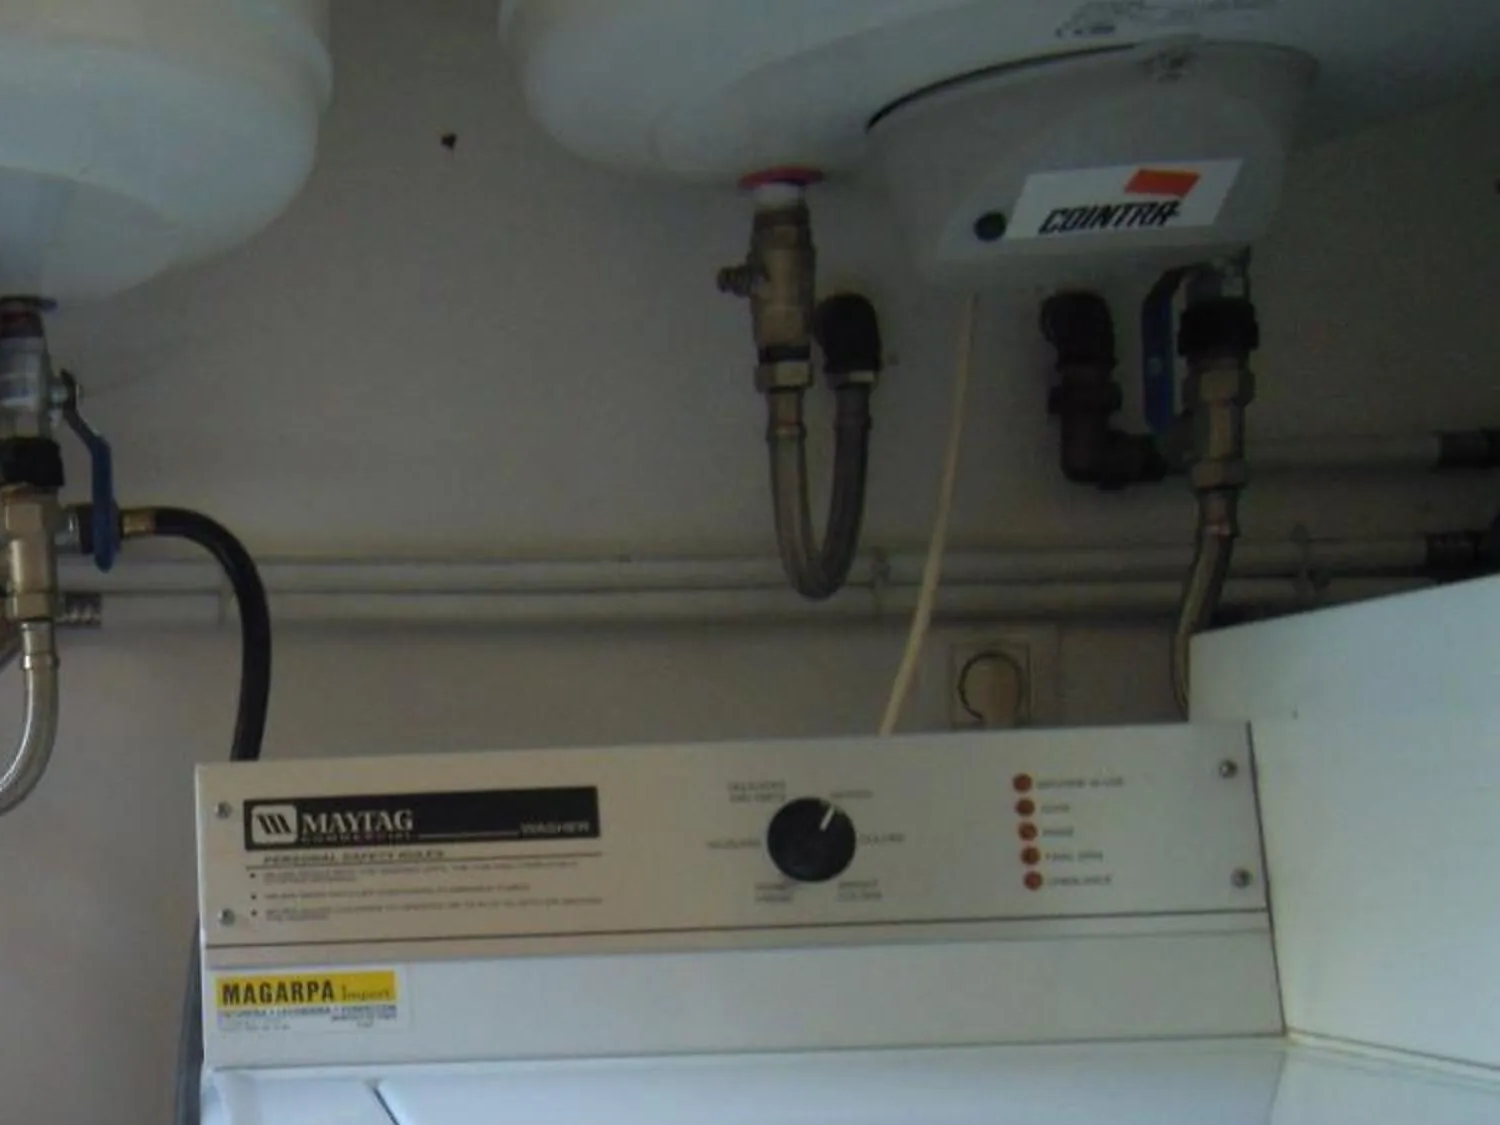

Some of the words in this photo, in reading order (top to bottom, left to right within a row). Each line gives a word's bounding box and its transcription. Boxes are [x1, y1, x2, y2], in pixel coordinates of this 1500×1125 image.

[1038, 200, 1181, 234] COINTRA
[301, 810, 415, 834] MAYTAG
[520, 821, 591, 835] WASHER
[222, 980, 335, 1006] MAGARPA
